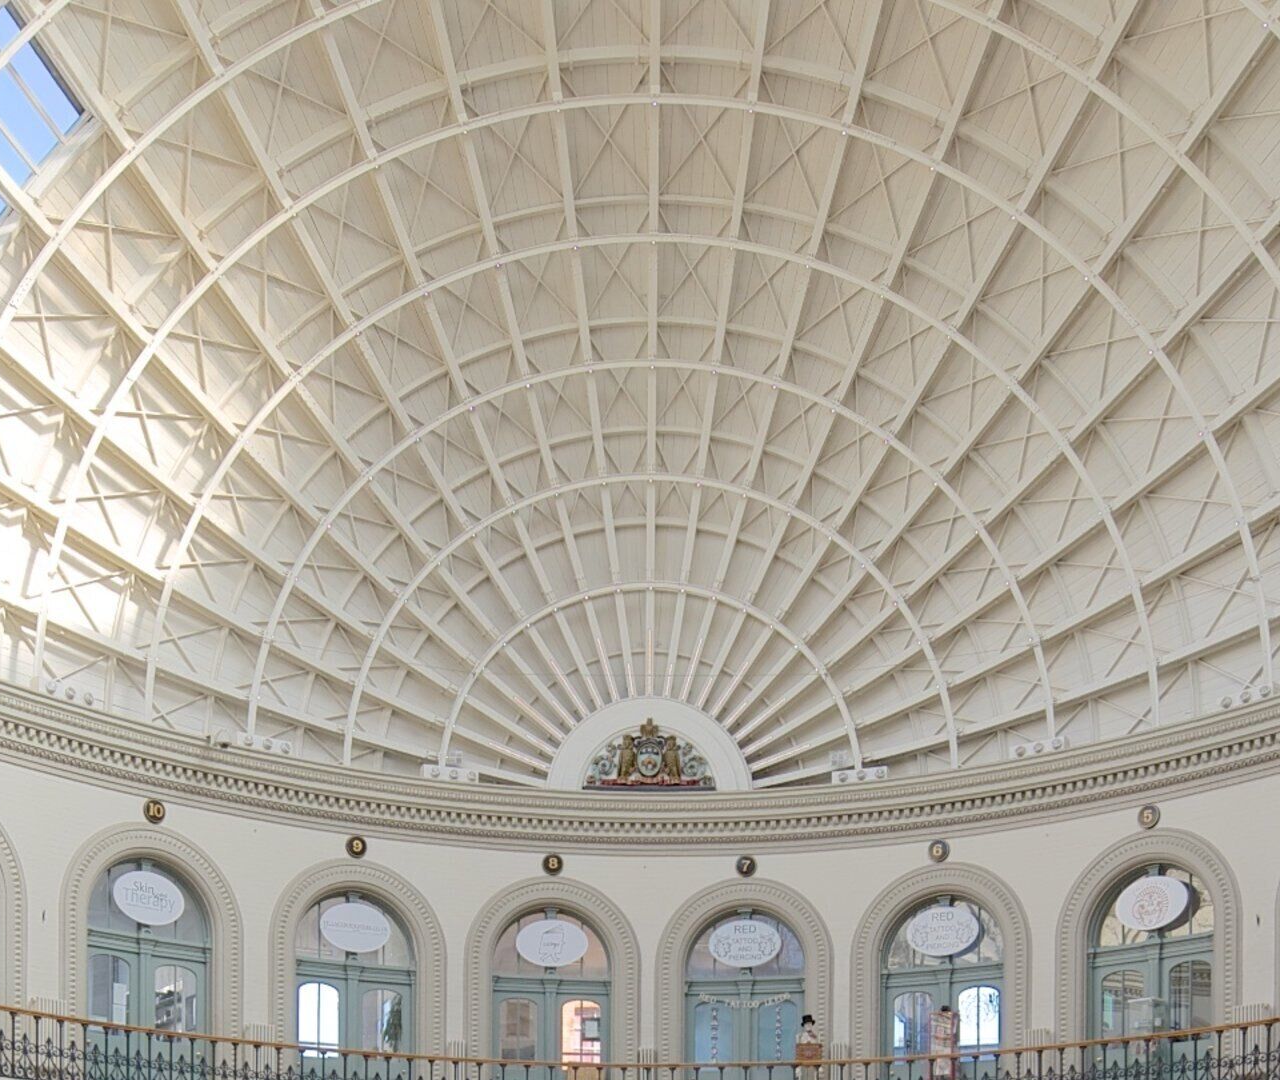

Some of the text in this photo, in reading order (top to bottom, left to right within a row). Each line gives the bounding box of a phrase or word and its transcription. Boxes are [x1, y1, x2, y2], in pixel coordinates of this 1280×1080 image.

[148, 802, 164, 818] 10
[1143, 809, 1153, 823] 5
[352, 839, 363, 852] 9
[932, 844, 943, 856] 6
[548, 857, 558, 869] 8
[741, 859, 751, 872] 7
[132, 880, 154, 894] Skin
[122, 887, 175, 913] Therapy
[931, 912, 954, 921] RED
[734, 924, 757, 934] RED
[731, 937, 761, 945] TATTOO
[728, 953, 762, 961] PIERCING
[699, 992, 717, 1004] RED
